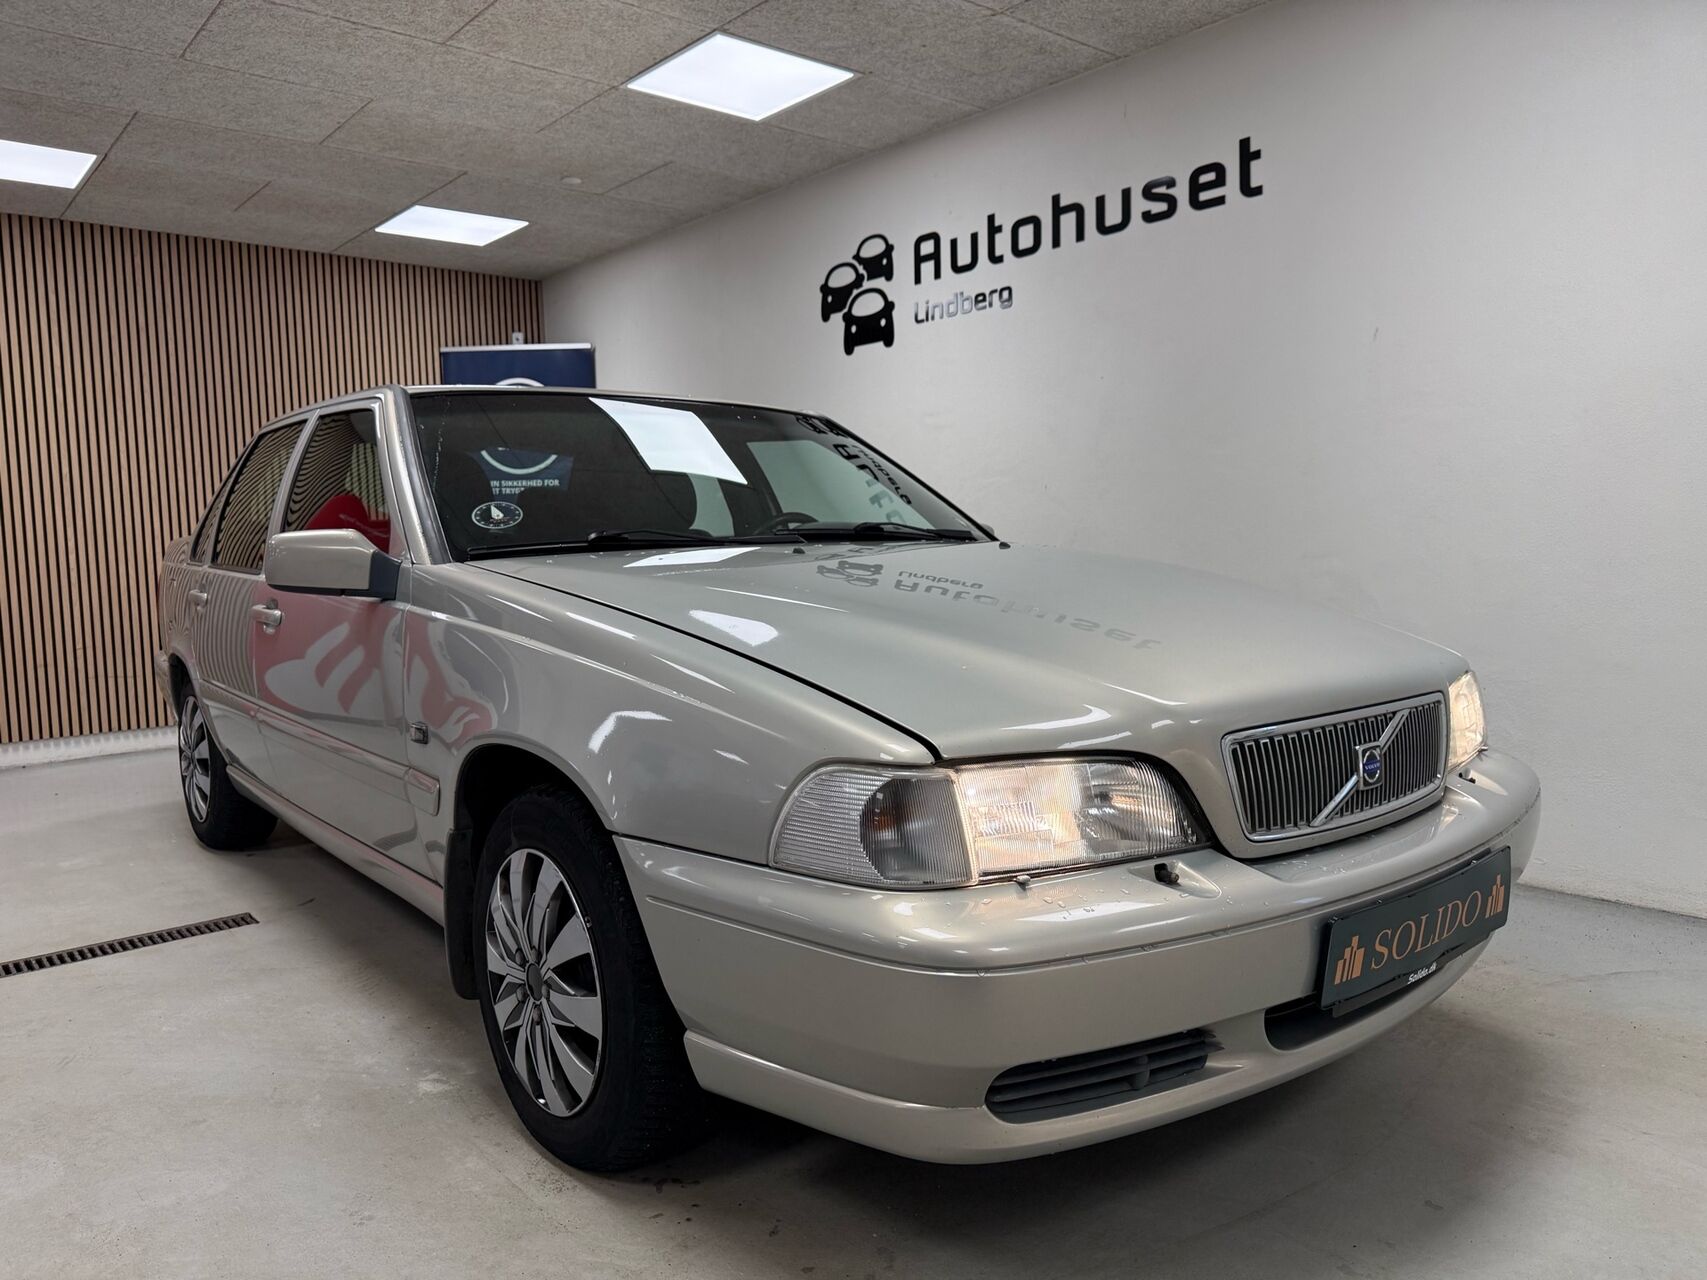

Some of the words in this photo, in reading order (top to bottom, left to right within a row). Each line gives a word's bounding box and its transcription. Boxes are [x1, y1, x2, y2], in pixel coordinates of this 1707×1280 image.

[914, 137, 1264, 285] Autohuset
[914, 286, 1013, 324] Lindberg
[1371, 890, 1482, 970] SOLIDO
